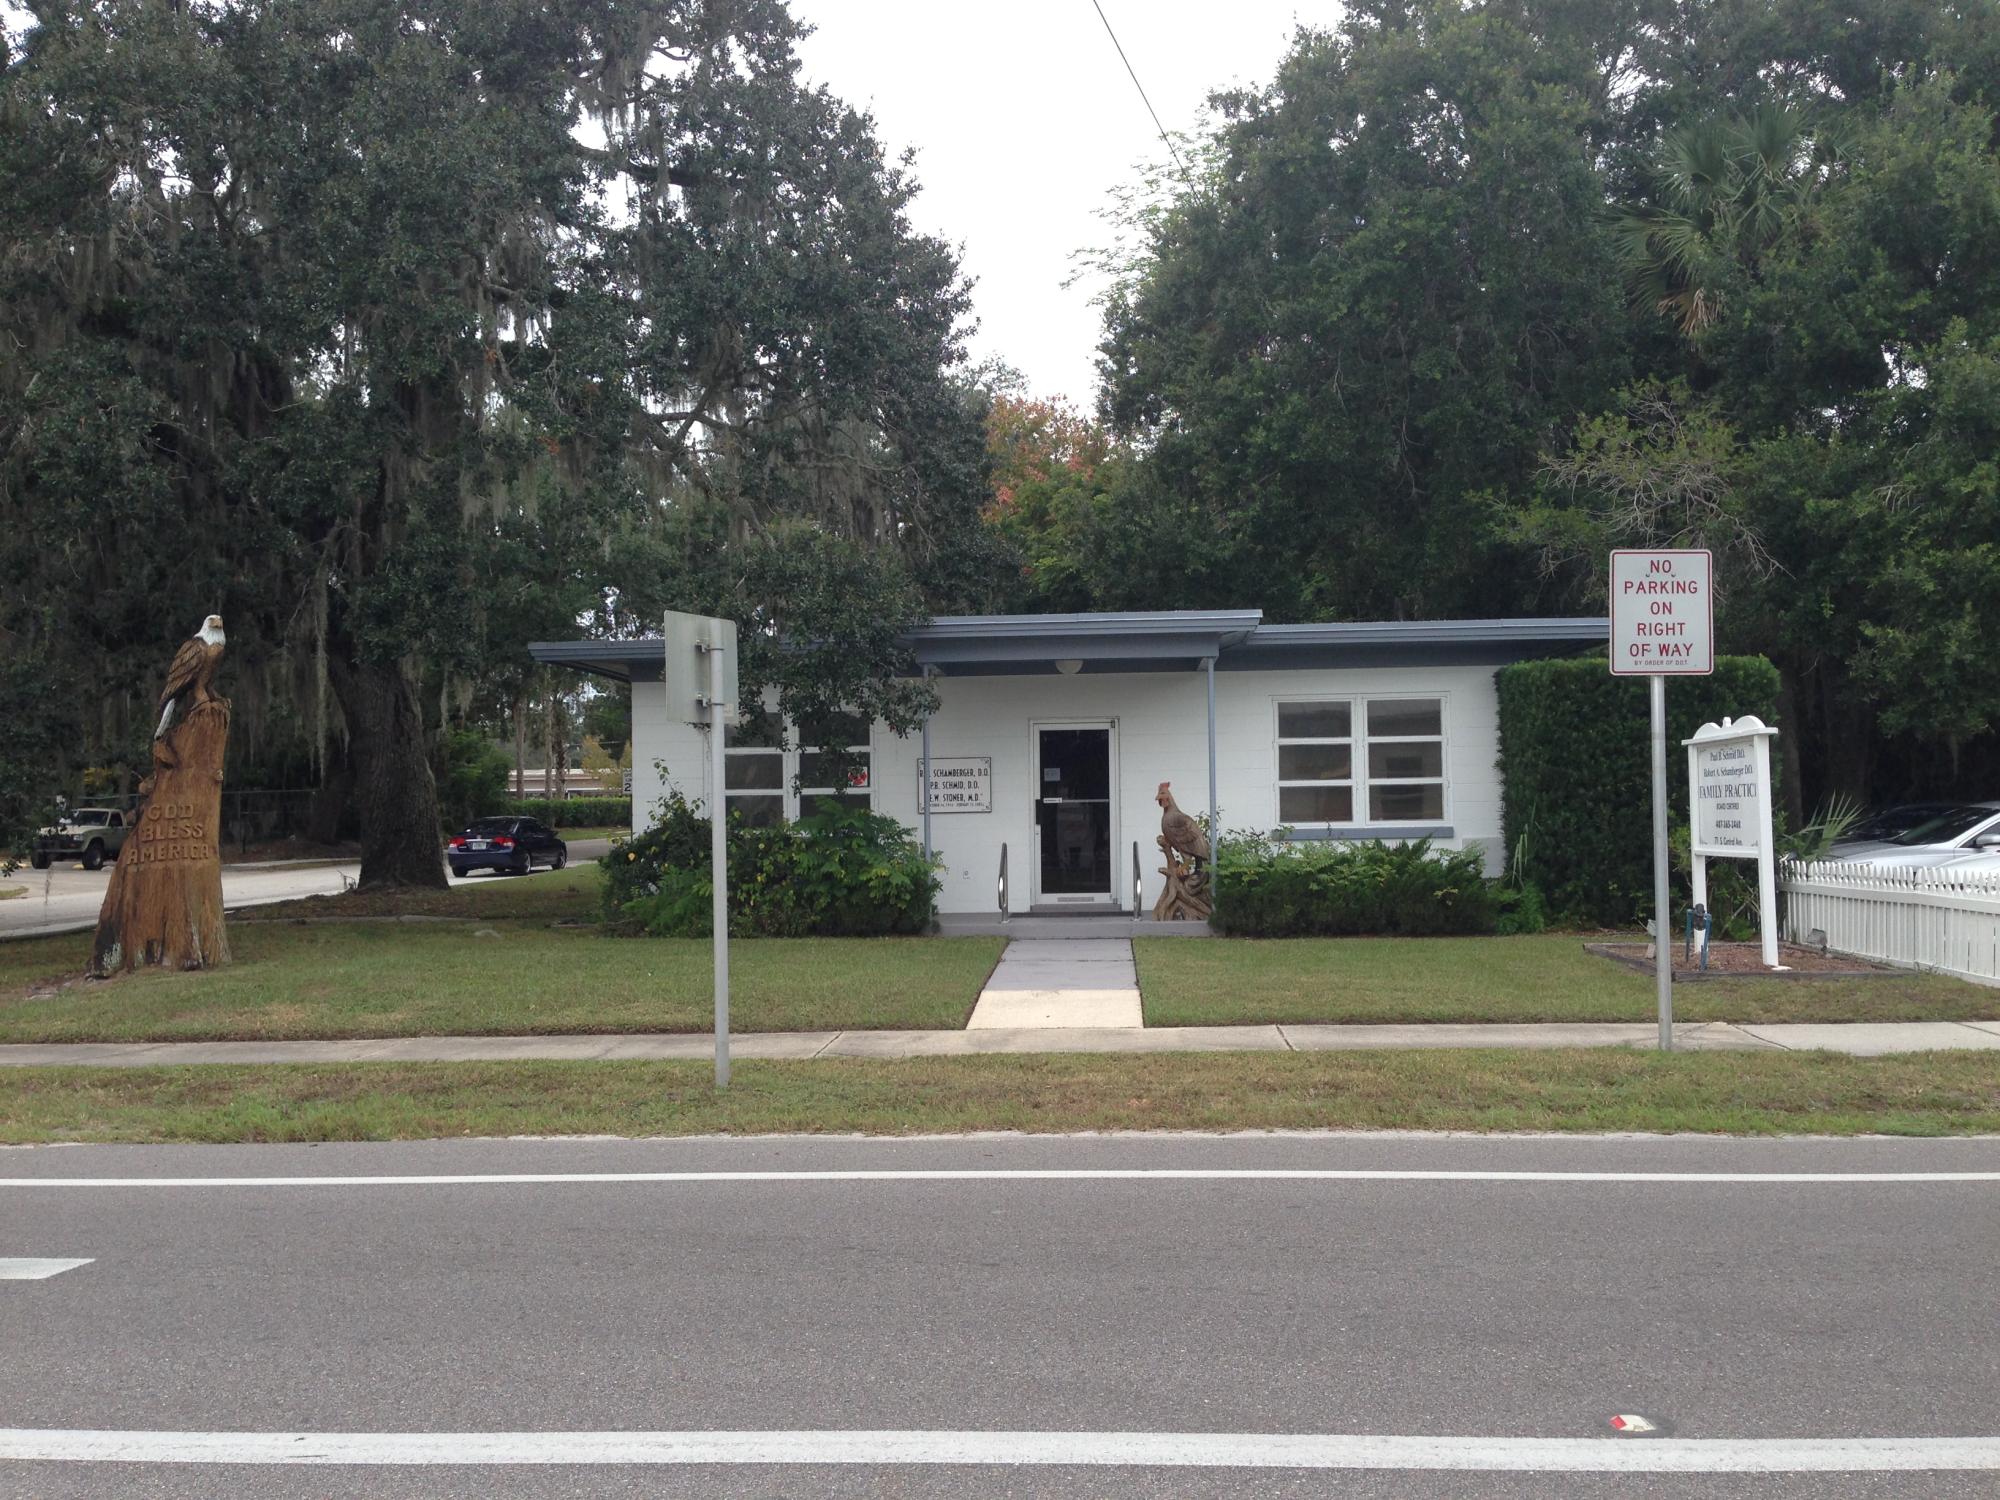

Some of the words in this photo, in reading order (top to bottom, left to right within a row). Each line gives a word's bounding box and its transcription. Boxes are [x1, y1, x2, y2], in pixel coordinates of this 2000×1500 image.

[1650, 560, 1672, 573] NO
[1624, 581, 1698, 594] PARKING
[1650, 602, 1672, 615] ON
[1637, 623, 1686, 636] RIGHT
[1629, 643, 1651, 657] OF
[1659, 643, 1693, 656] WAY
[1699, 784, 1722, 798] FAMILY
[148, 803, 195, 821] GOD
[141, 823, 204, 843] BLESS
[126, 844, 209, 865] AMERICA
